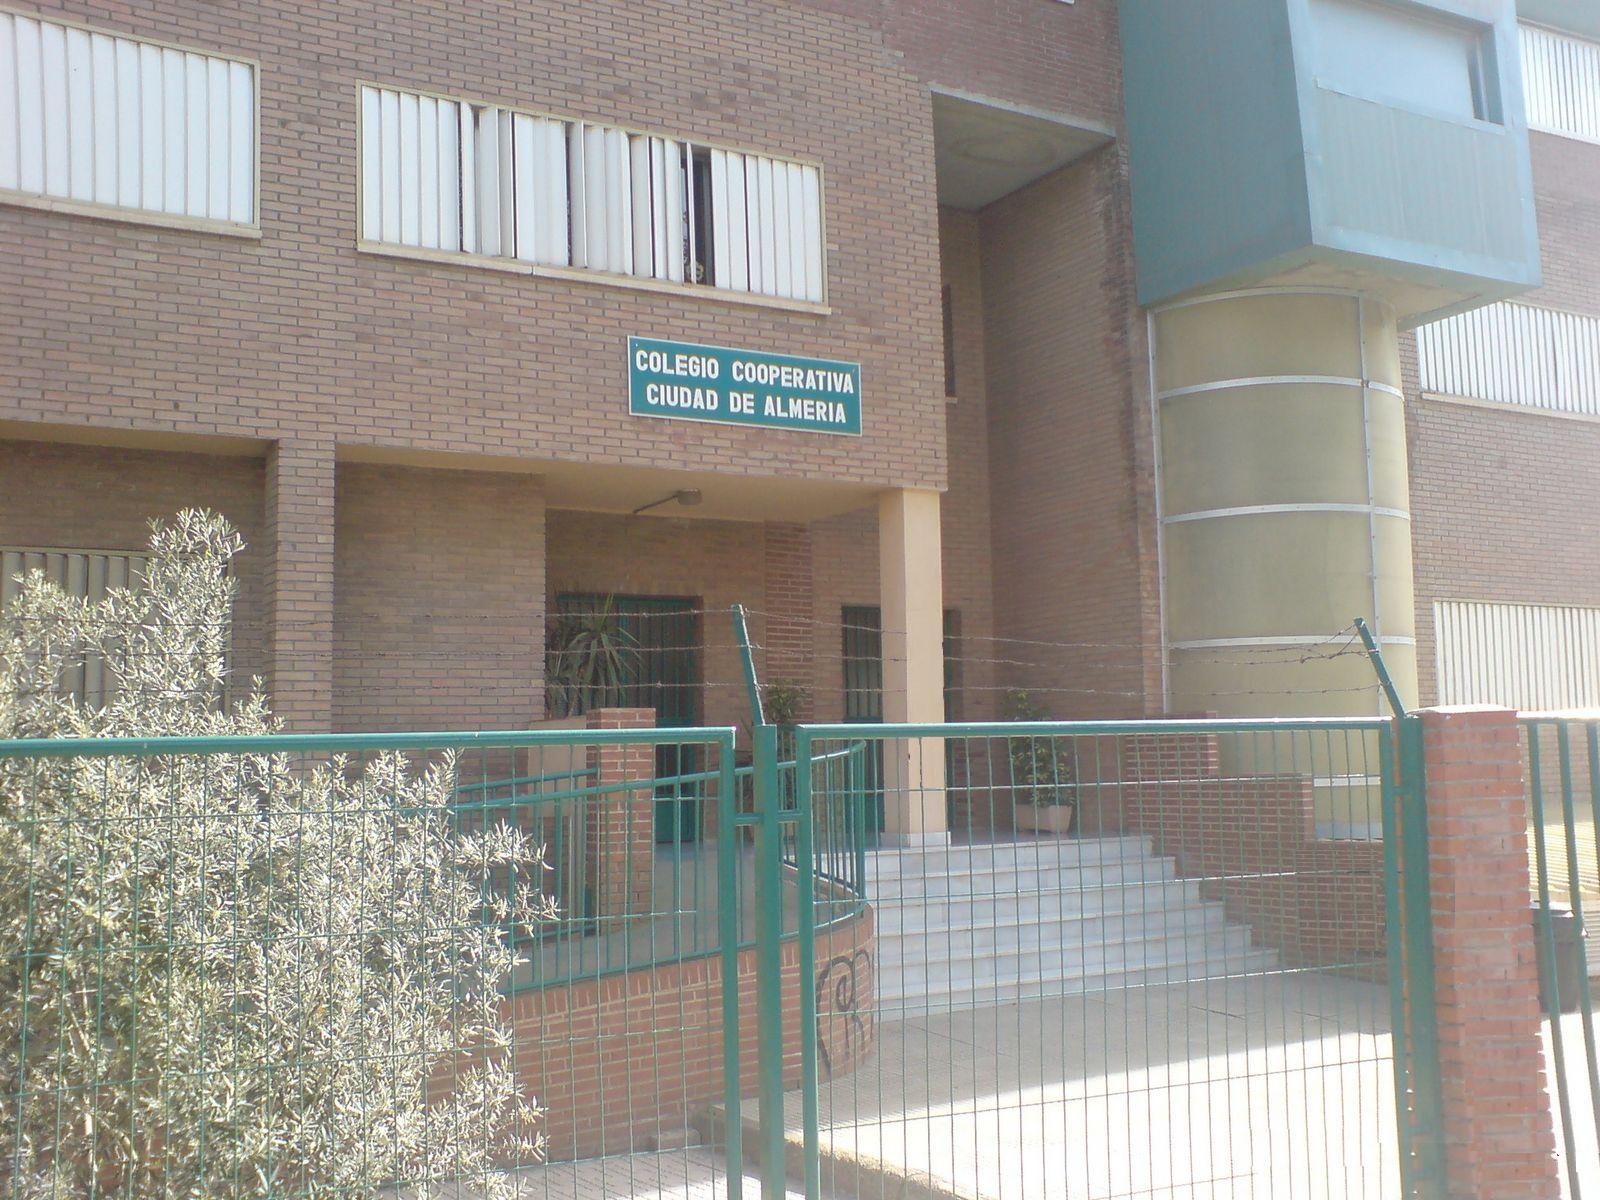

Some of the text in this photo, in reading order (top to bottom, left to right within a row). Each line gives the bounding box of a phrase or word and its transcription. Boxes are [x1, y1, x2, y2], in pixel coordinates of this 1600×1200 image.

[635, 350, 854, 394] COLEGIO COOPERATIVA
[646, 383, 847, 423] CIUDAD DE ALMERIA
